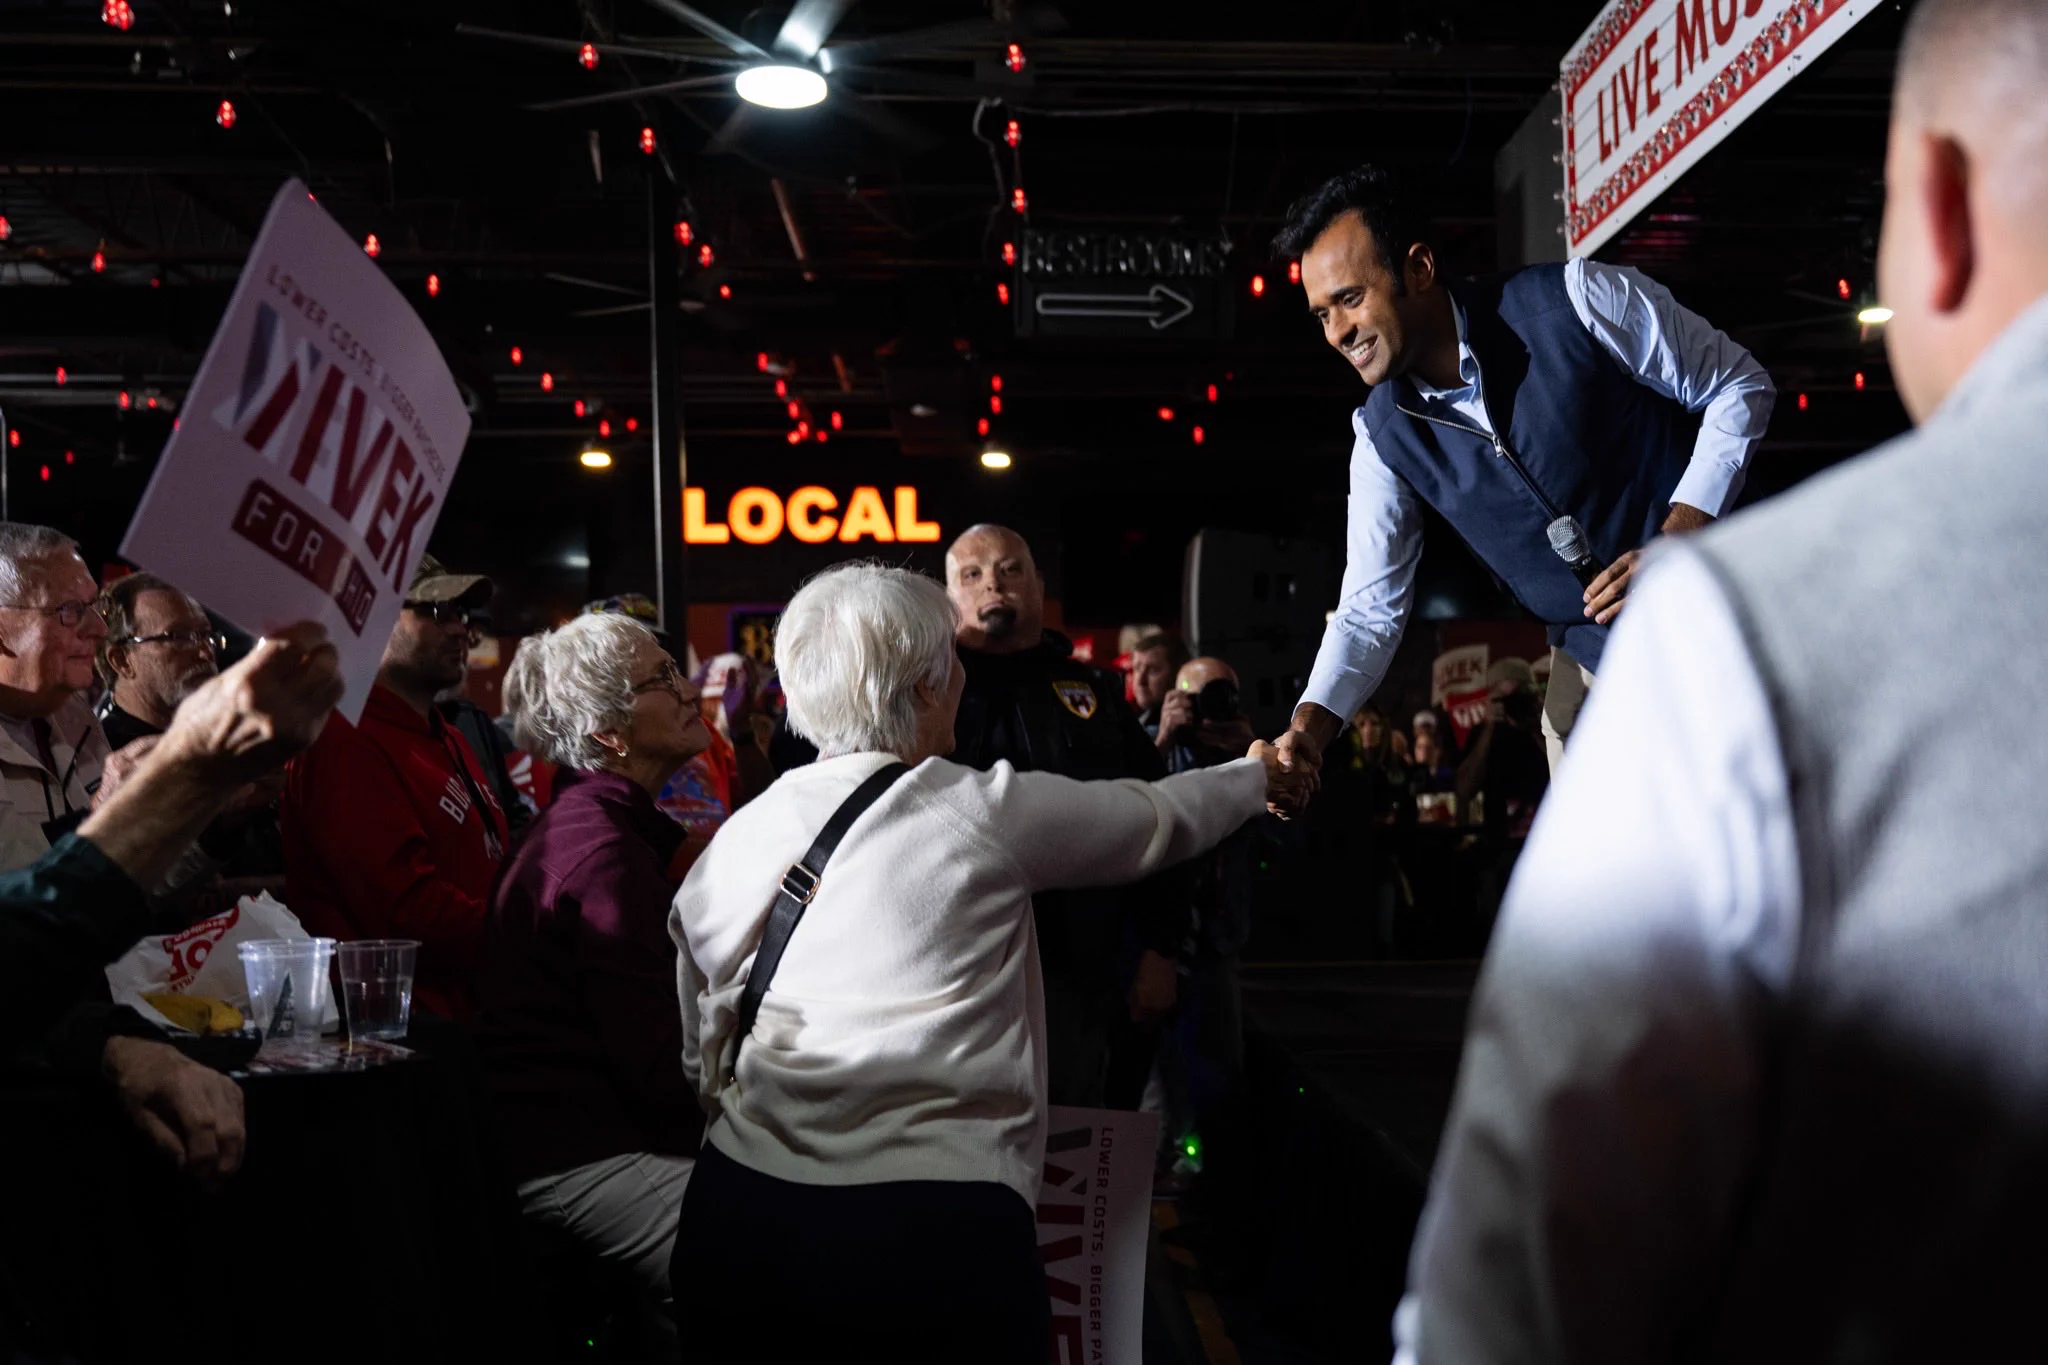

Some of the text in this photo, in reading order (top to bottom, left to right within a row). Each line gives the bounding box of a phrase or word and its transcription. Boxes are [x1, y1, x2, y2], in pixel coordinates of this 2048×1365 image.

[1597, 27, 1661, 163] LIVE
[1021, 230, 1226, 276] RESTROOMS
[232, 300, 435, 595] VIVEK
[243, 491, 324, 571] FOR
[682, 485, 942, 544] LOCAL
[1096, 1127, 1114, 1188] LOWER
[1089, 1265, 1103, 1332] BIGGER
